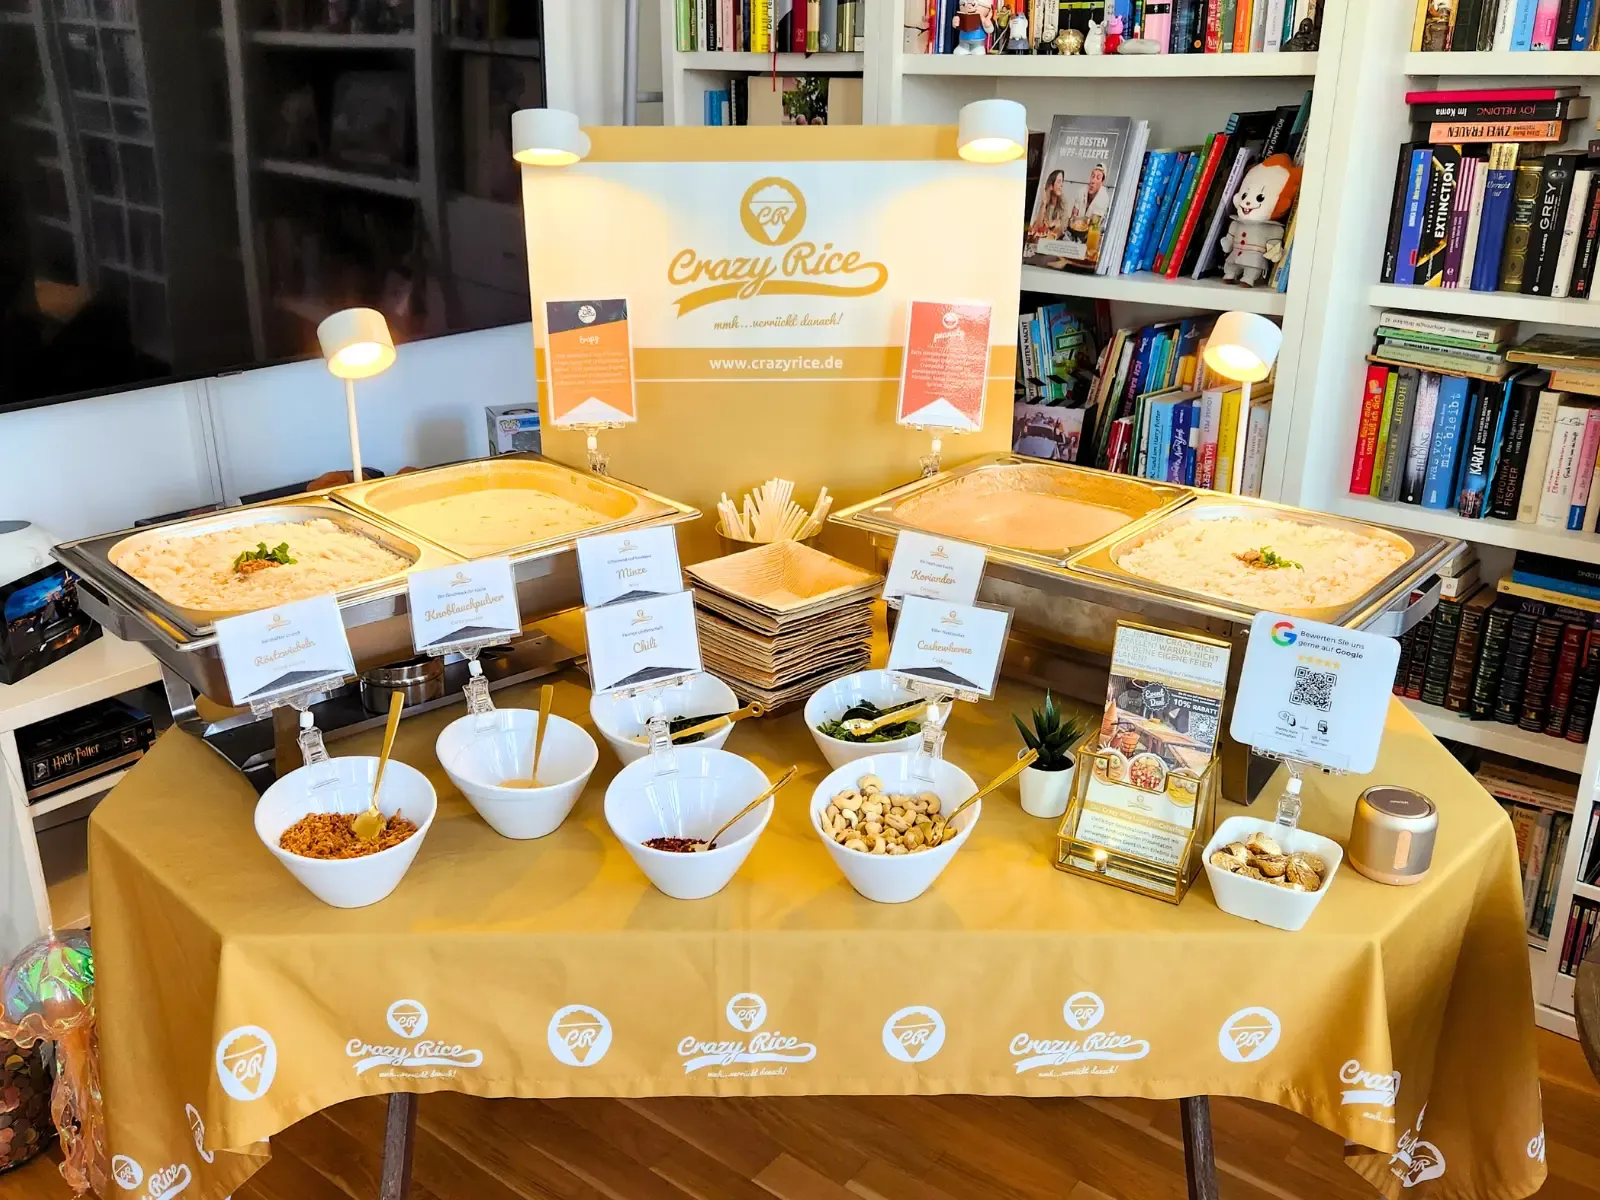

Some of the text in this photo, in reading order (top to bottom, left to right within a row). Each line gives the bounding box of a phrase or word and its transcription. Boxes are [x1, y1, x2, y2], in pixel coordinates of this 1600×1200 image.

[1435, 107, 1535, 118] JOY FIELDING Im Koma
[1065, 136, 1108, 148] DIE BESTEN
[1268, 117, 1284, 146] ROLAND
[1446, 126, 1511, 140] ZWEI FRAUEN
[1431, 161, 1456, 239] EXTINCTION
[1538, 182, 1556, 230] GREY
[755, 205, 791, 227] CR
[668, 242, 865, 301] Crazy Rice
[713, 312, 844, 331] mmh...verrückt danach!
[709, 357, 843, 371] www.crazyrice.de
[1371, 394, 1381, 410] dich
[1393, 385, 1407, 424] HOBBIT
[1369, 410, 1379, 421] ich
[1442, 392, 1460, 439] bleibt
[1152, 428, 1160, 445] Harry
[1364, 436, 1374, 455] sonst
[1431, 430, 1443, 454] von
[1505, 440, 1513, 453] Das
[1414, 432, 1430, 472] FIELDING
[1438, 444, 1452, 469] mir
[1513, 441, 1521, 454] vom
[1427, 457, 1439, 481] was
[1467, 444, 1486, 476] KARAT
[1494, 457, 1510, 505] VERONIKA
[1502, 466, 1518, 507] FISCHER
[616, 568, 647, 579] Minze
[911, 570, 956, 584] Koriander
[425, 593, 504, 621] Knoblauchpulver
[633, 636, 658, 654] Chili
[917, 640, 972, 654] Cashewkerne
[1150, 633, 1216, 654] DIR CRAZY RICE
[1298, 640, 1320, 650] gerne
[1336, 648, 1363, 660] Google
[1300, 630, 1365, 650] Bewerten Sie uns
[254, 637, 316, 666] Röstzwiebeln
[1132, 644, 1157, 656] DEINE
[1157, 650, 1189, 663] EIGENE
[1189, 656, 1214, 668] FEIER
[1158, 642, 1193, 657] WARUM
[1193, 650, 1220, 662] NICHT
[1145, 688, 1165, 698] Event
[1173, 698, 1191, 709] 10%
[1192, 704, 1217, 715] RABATT
[52, 744, 100, 770] Harry Potter
[564, 1027, 596, 1049] CR
[677, 1031, 798, 1065] Crazy Rice
[898, 1028, 929, 1047] CR
[1009, 1031, 1132, 1065] Crazy Rice
[1234, 1031, 1265, 1048] CR
[345, 1038, 464, 1065] Crazy Rice
[234, 1053, 264, 1082] CR
